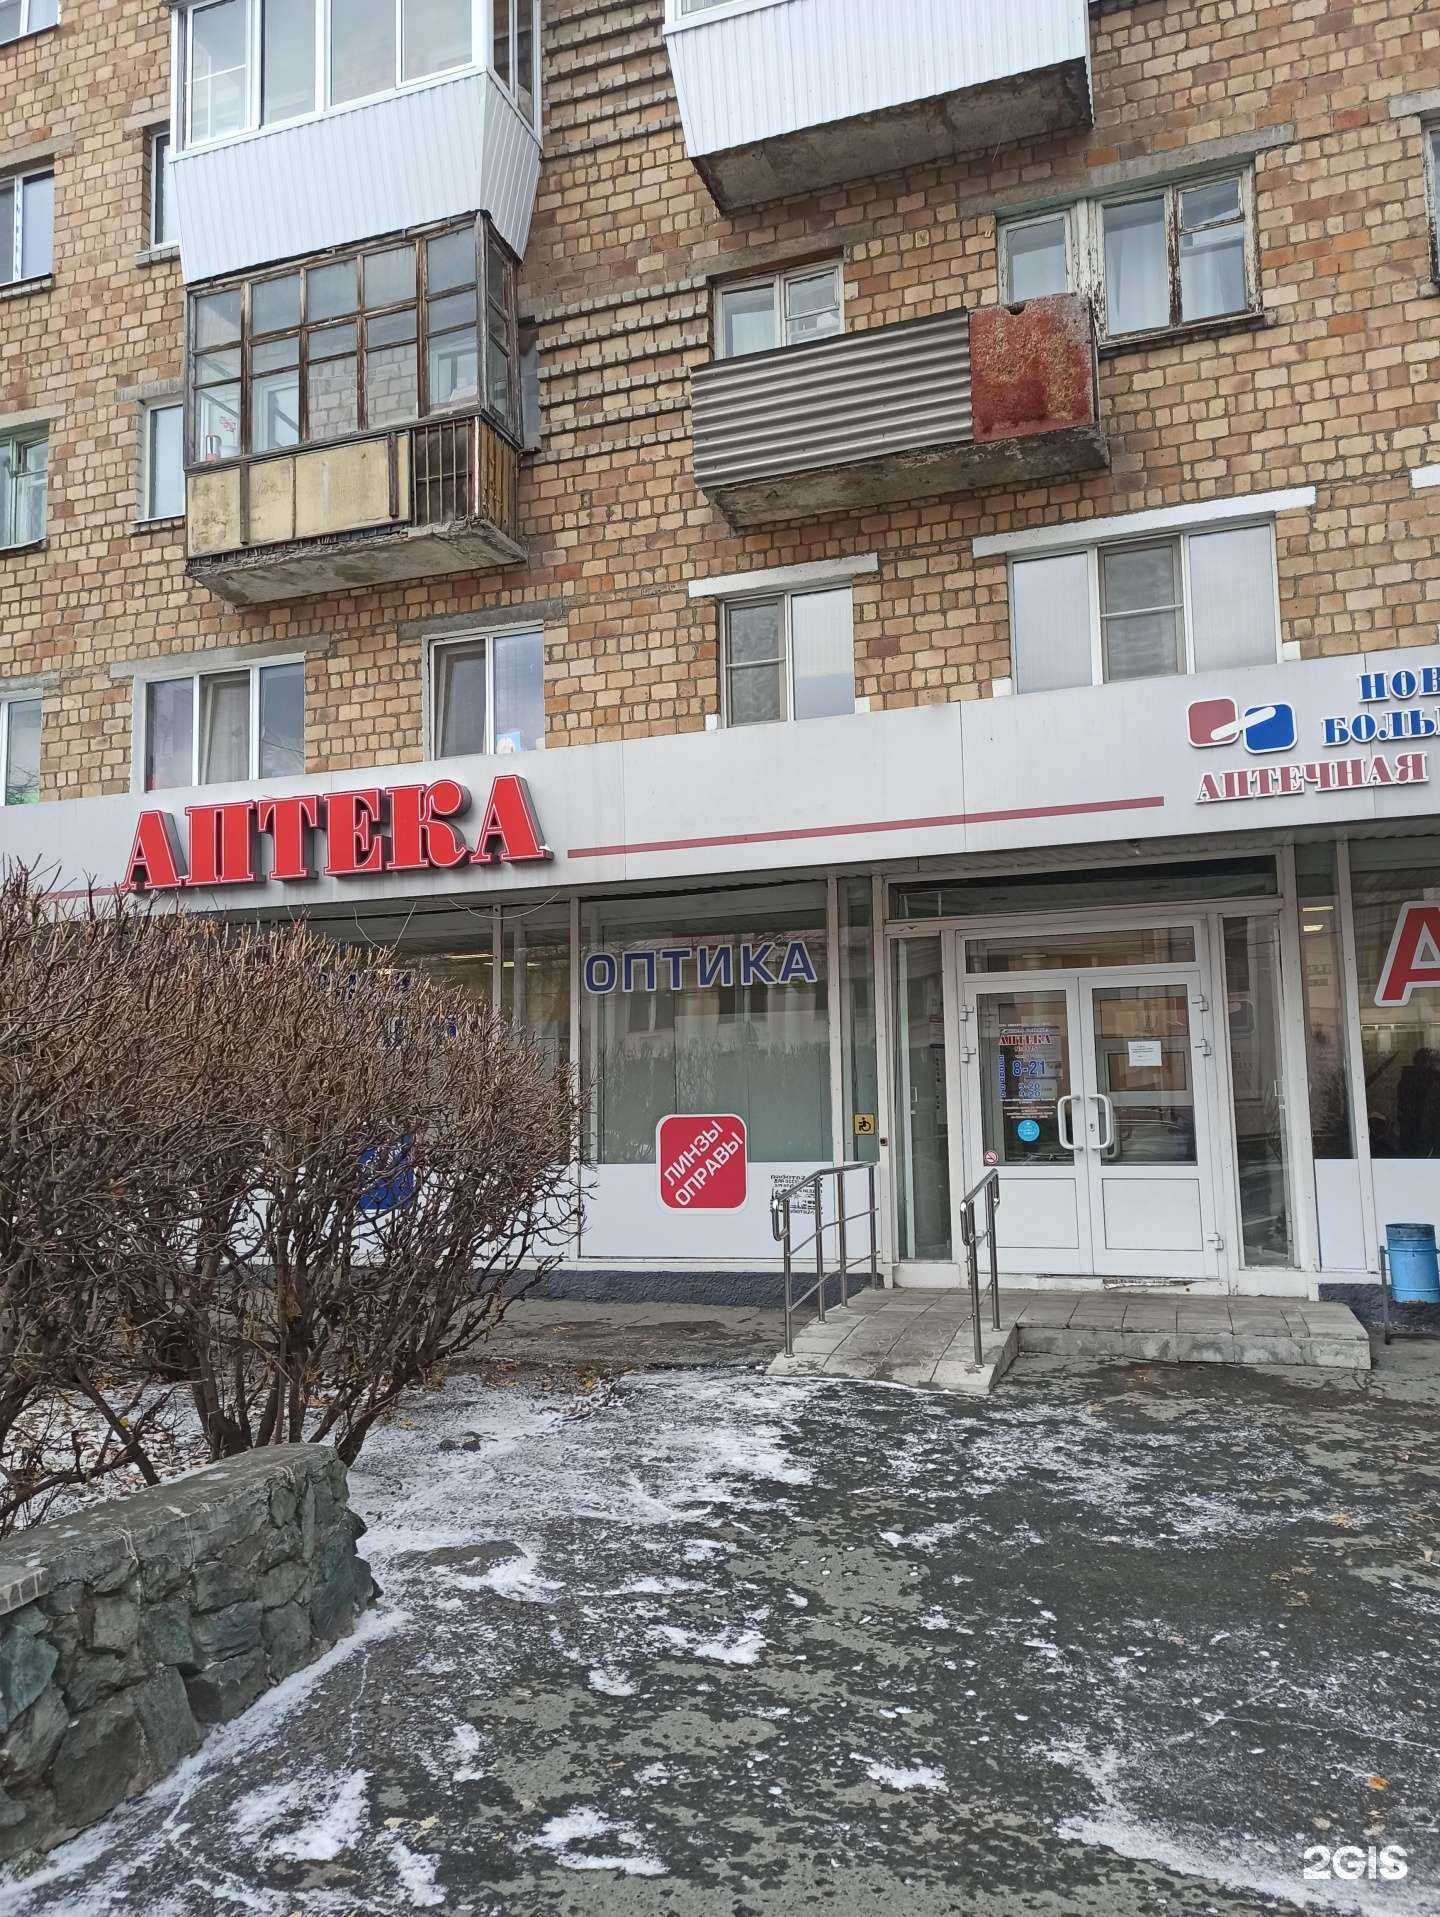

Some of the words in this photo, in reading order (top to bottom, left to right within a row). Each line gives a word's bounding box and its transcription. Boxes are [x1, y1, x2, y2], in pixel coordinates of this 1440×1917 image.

[1321, 705, 1440, 747] БОЛЬ
[1195, 752, 1430, 804] АПТЕЧНАЯ
[120, 774, 553, 892] АПТЕКА
[584, 941, 818, 994] ОПТИКА
[1012, 1059, 1046, 1077] 8-21
[664, 1120, 723, 1186] ЛИНЗЫ
[675, 1132, 743, 1205] ОПРАВЫ
